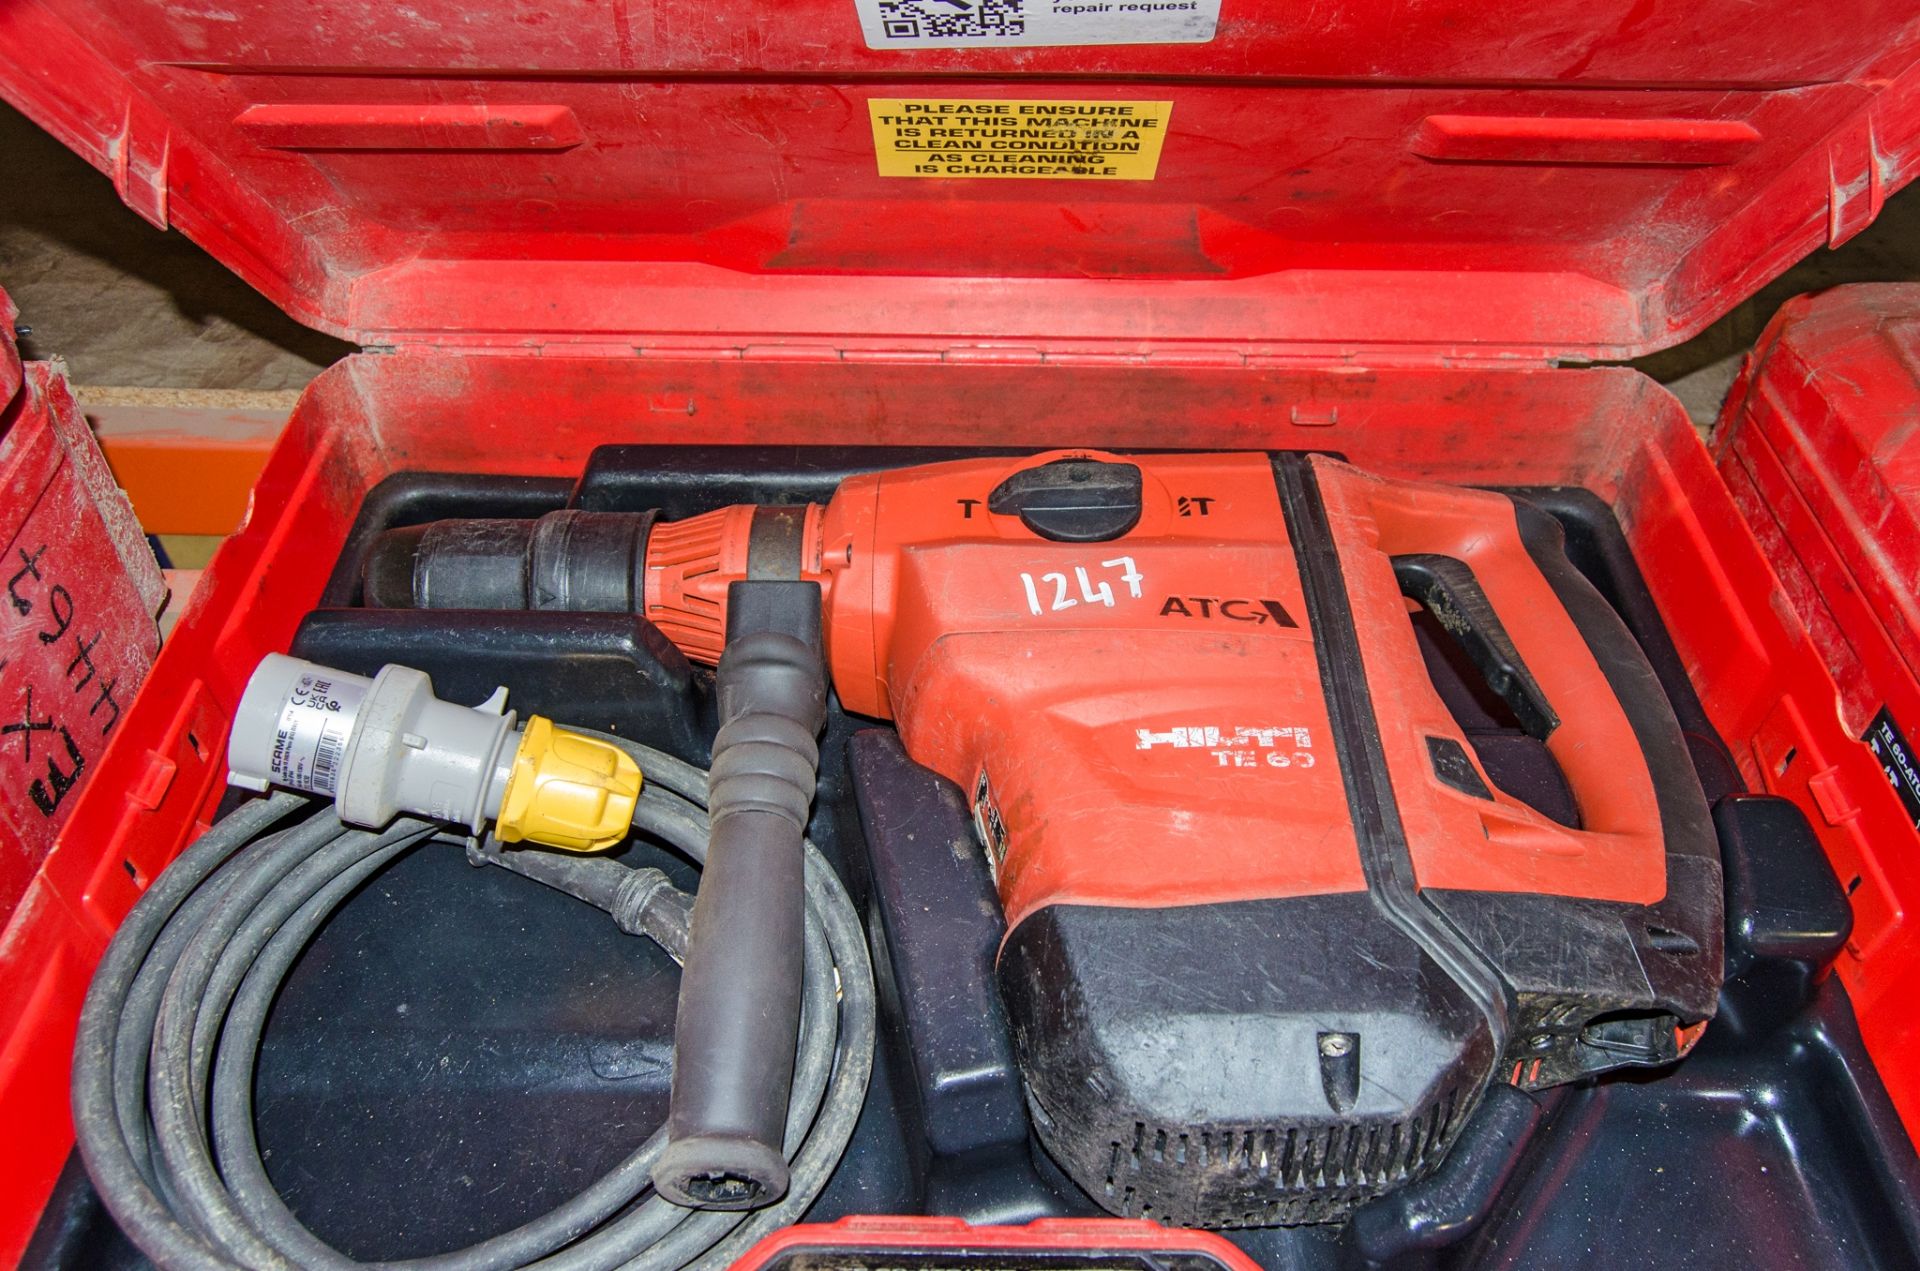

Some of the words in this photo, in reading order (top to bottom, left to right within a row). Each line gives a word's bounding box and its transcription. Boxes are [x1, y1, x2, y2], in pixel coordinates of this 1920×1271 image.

[1053, 3, 1113, 14] repair
[1119, 1, 1198, 12] request
[904, 104, 1010, 114] PLEASE
[1019, 105, 1134, 115] ENSURE
[878, 116, 949, 125] THAT
[955, 117, 1018, 126] THIS
[1026, 117, 1159, 128] MACHINE
[896, 128, 921, 137] IS
[930, 128, 1077, 138] RETURNED
[1121, 130, 1140, 139] A
[894, 139, 982, 149] CLEAN
[990, 140, 1140, 151] CONDITION
[928, 153, 963, 163] AS
[970, 154, 1105, 164] CLEANING
[915, 164, 939, 173] IS
[946, 165, 1118, 175] CHARGEABLE
[1020, 556, 1144, 616] 1247
[1136, 726, 1312, 750] HILTI
[1880, 722, 1895, 744] TE
[271, 729, 288, 773] SCAME
[1211, 750, 1257, 767] TE
